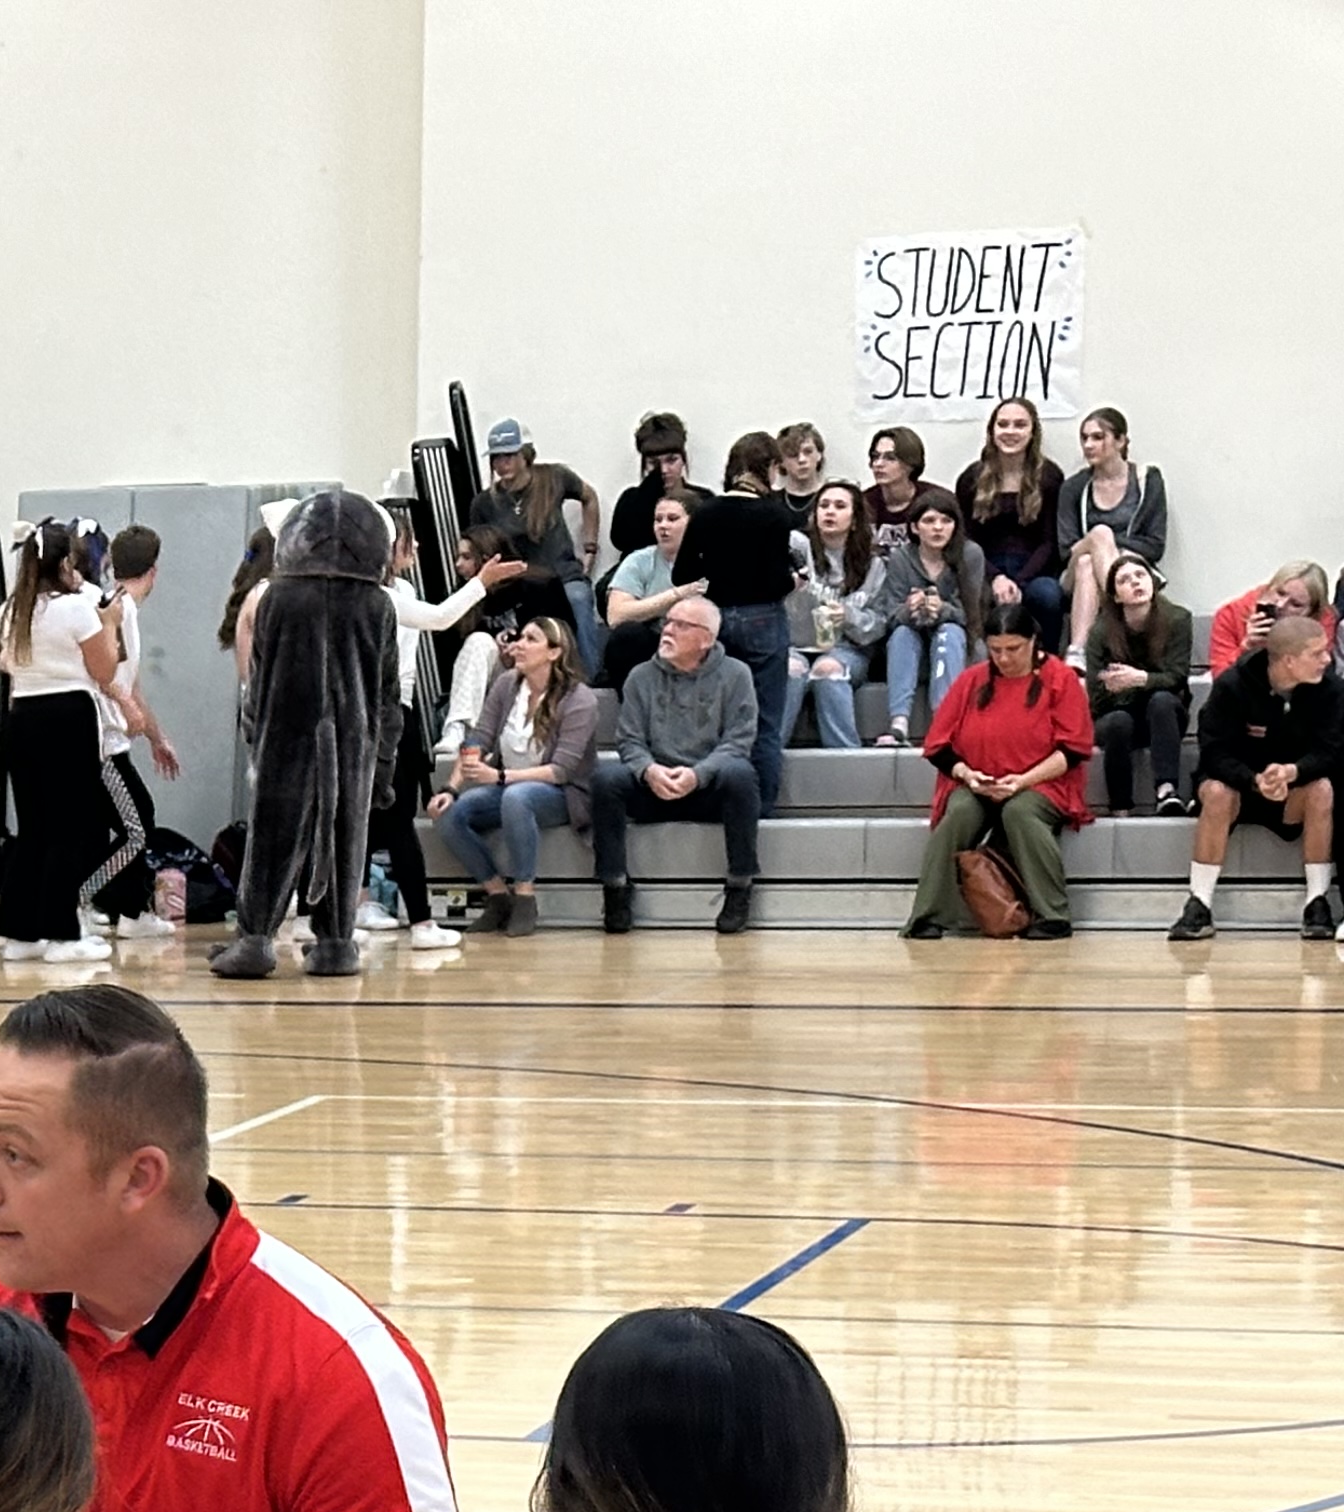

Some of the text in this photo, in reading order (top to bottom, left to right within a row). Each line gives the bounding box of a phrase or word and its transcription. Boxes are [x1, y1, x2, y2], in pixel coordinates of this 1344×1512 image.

[874, 242, 1063, 319] STUDENT
[872, 320, 1056, 400] SECTION
[178, 1392, 250, 1421] ELK CREEK
[166, 1434, 237, 1462] BASKETBALL
